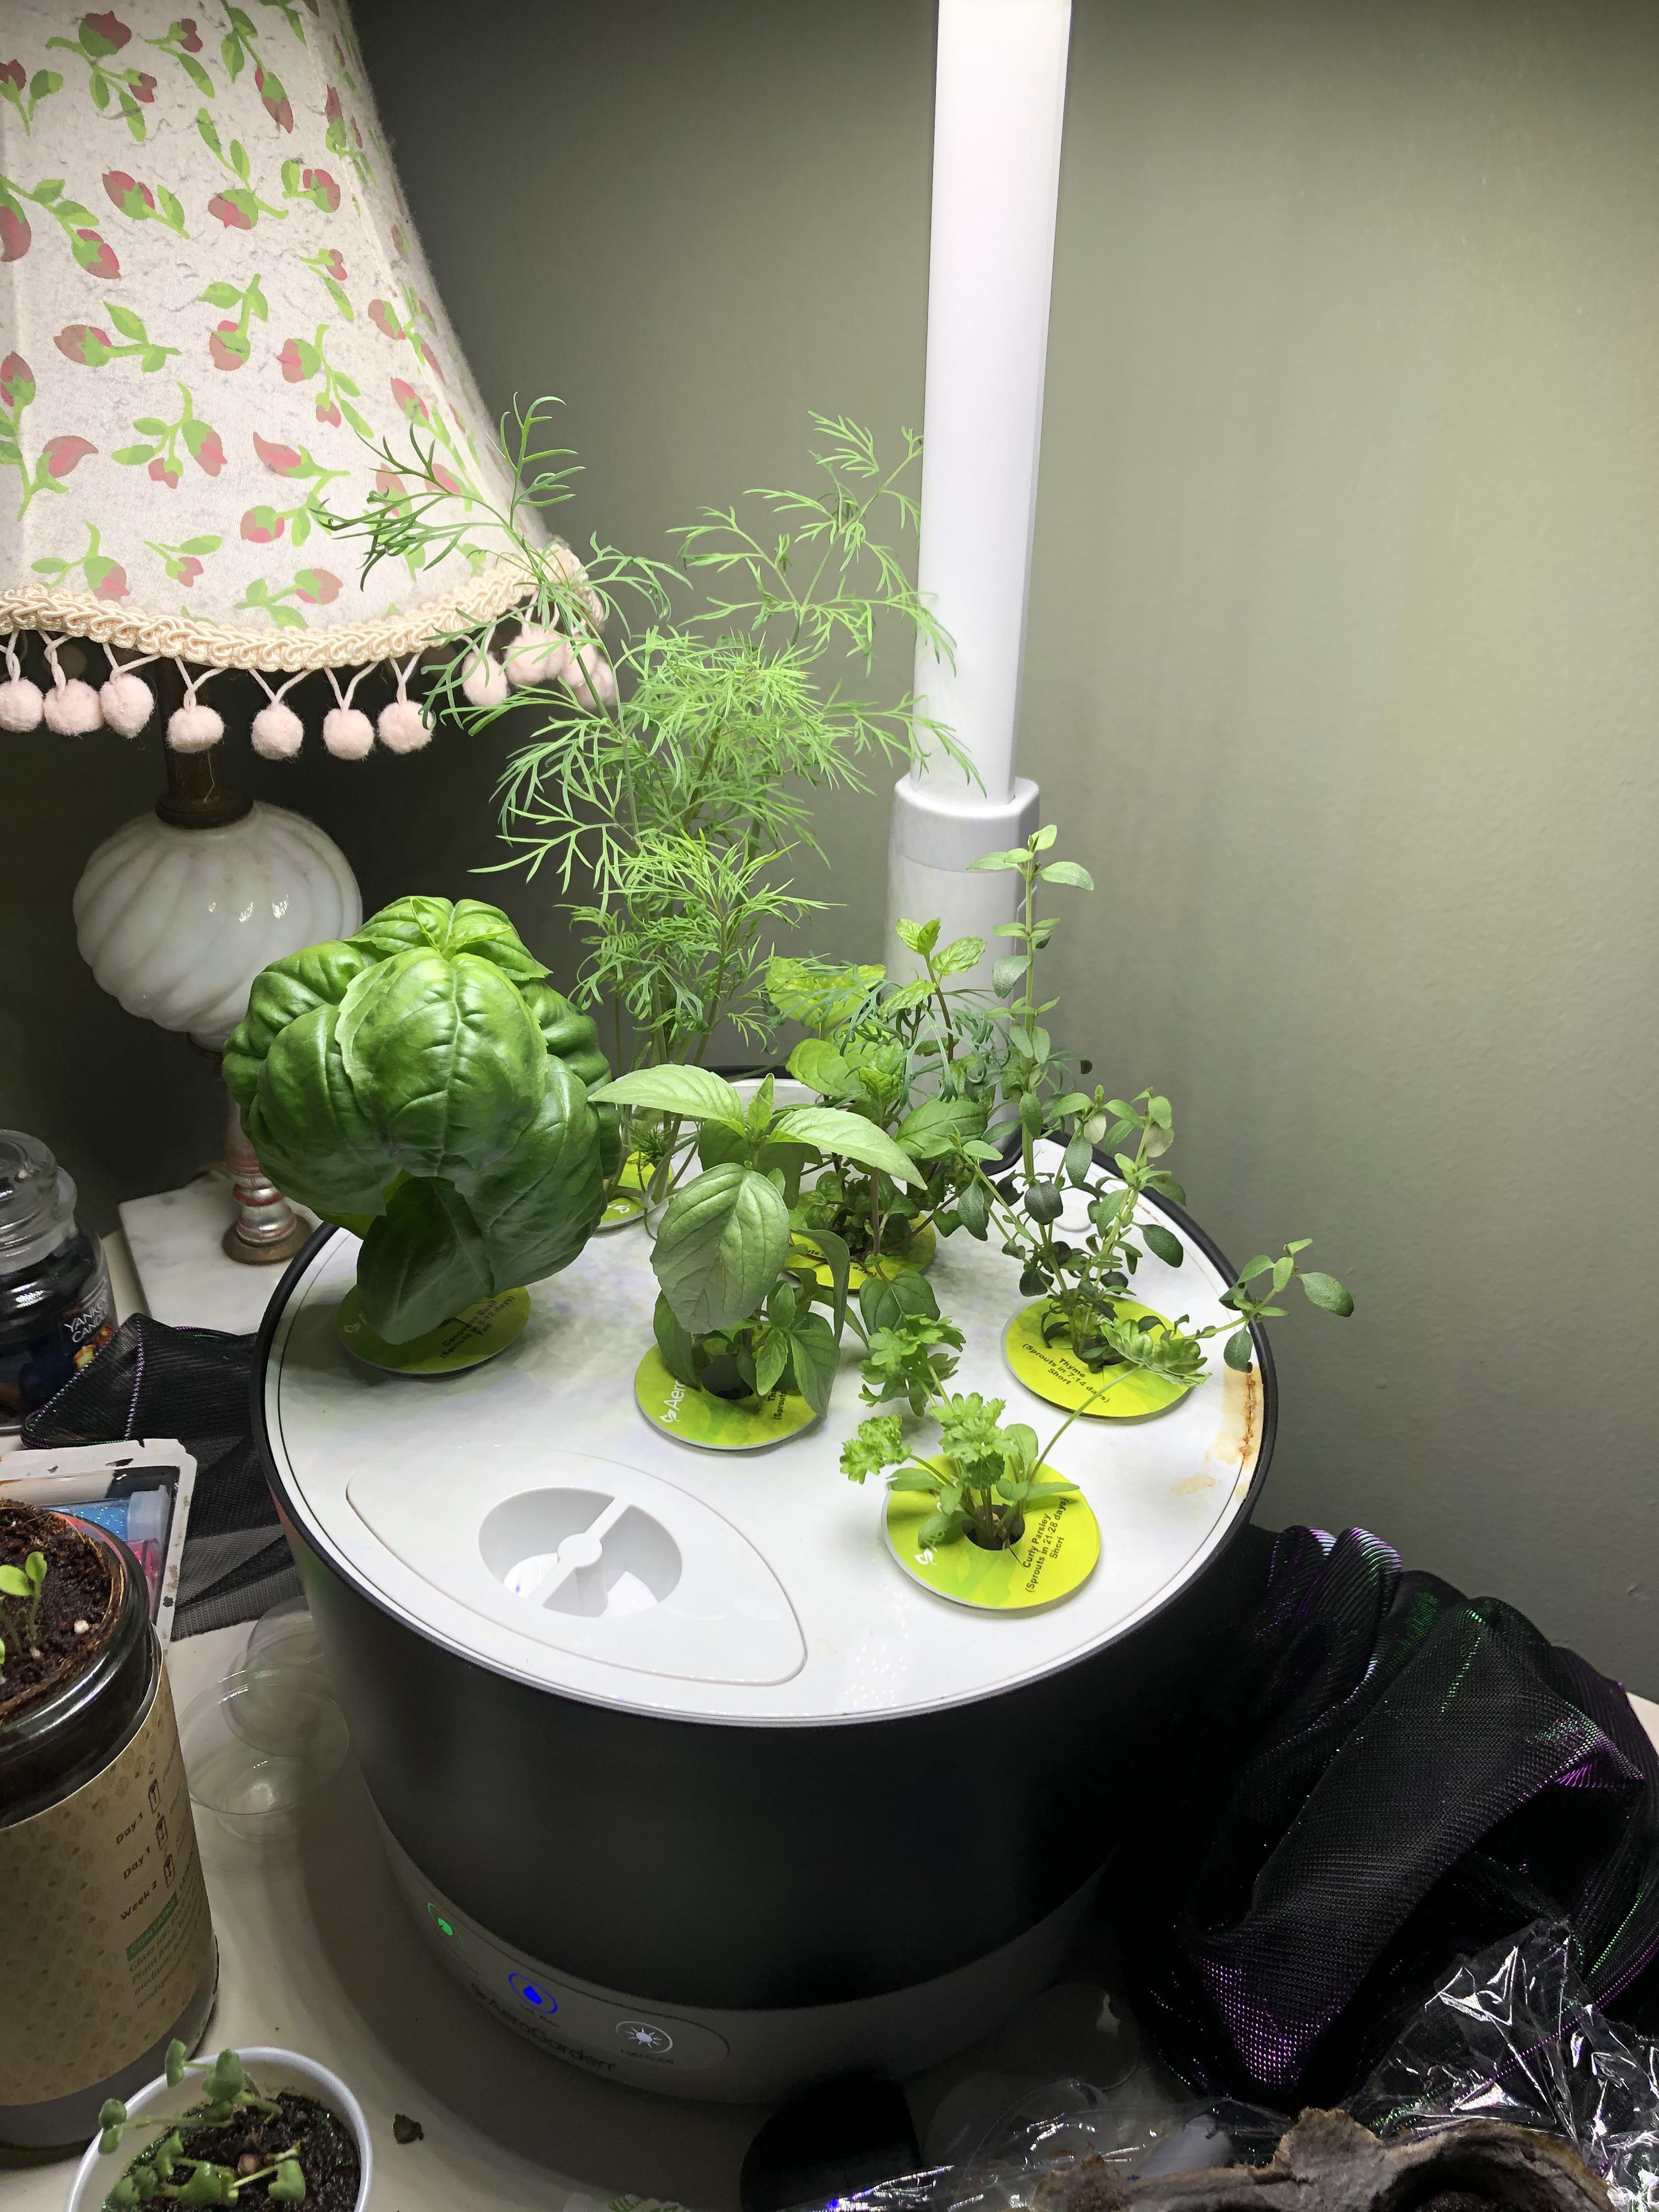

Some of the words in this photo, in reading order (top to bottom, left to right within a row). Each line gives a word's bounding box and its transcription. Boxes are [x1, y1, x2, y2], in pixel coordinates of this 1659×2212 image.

[495, 1295, 516, 1312] days)
[1022, 1343, 1057, 1367] (Sprouts
[1068, 1372, 1087, 1386] 7-14
[1086, 1386, 1110, 1403] das)
[1047, 1368, 1071, 1385] Short
[1059, 1358, 1086, 1378] Thyme
[1053, 1497, 1070, 1521] days)
[1023, 1545, 1039, 1568] Curly
[1031, 1513, 1052, 1545] Parsley
[1042, 1521, 1058, 1545] 21-28
[1041, 1546, 1049, 1555] in
[1024, 1556, 1045, 1593] (Sprouts
[116, 1820, 137, 1844] Day
[138, 1811, 143, 1819] 1
[123, 1855, 144, 1879] Day
[120, 1890, 150, 1920] Week
[152, 1880, 157, 1890] 2
